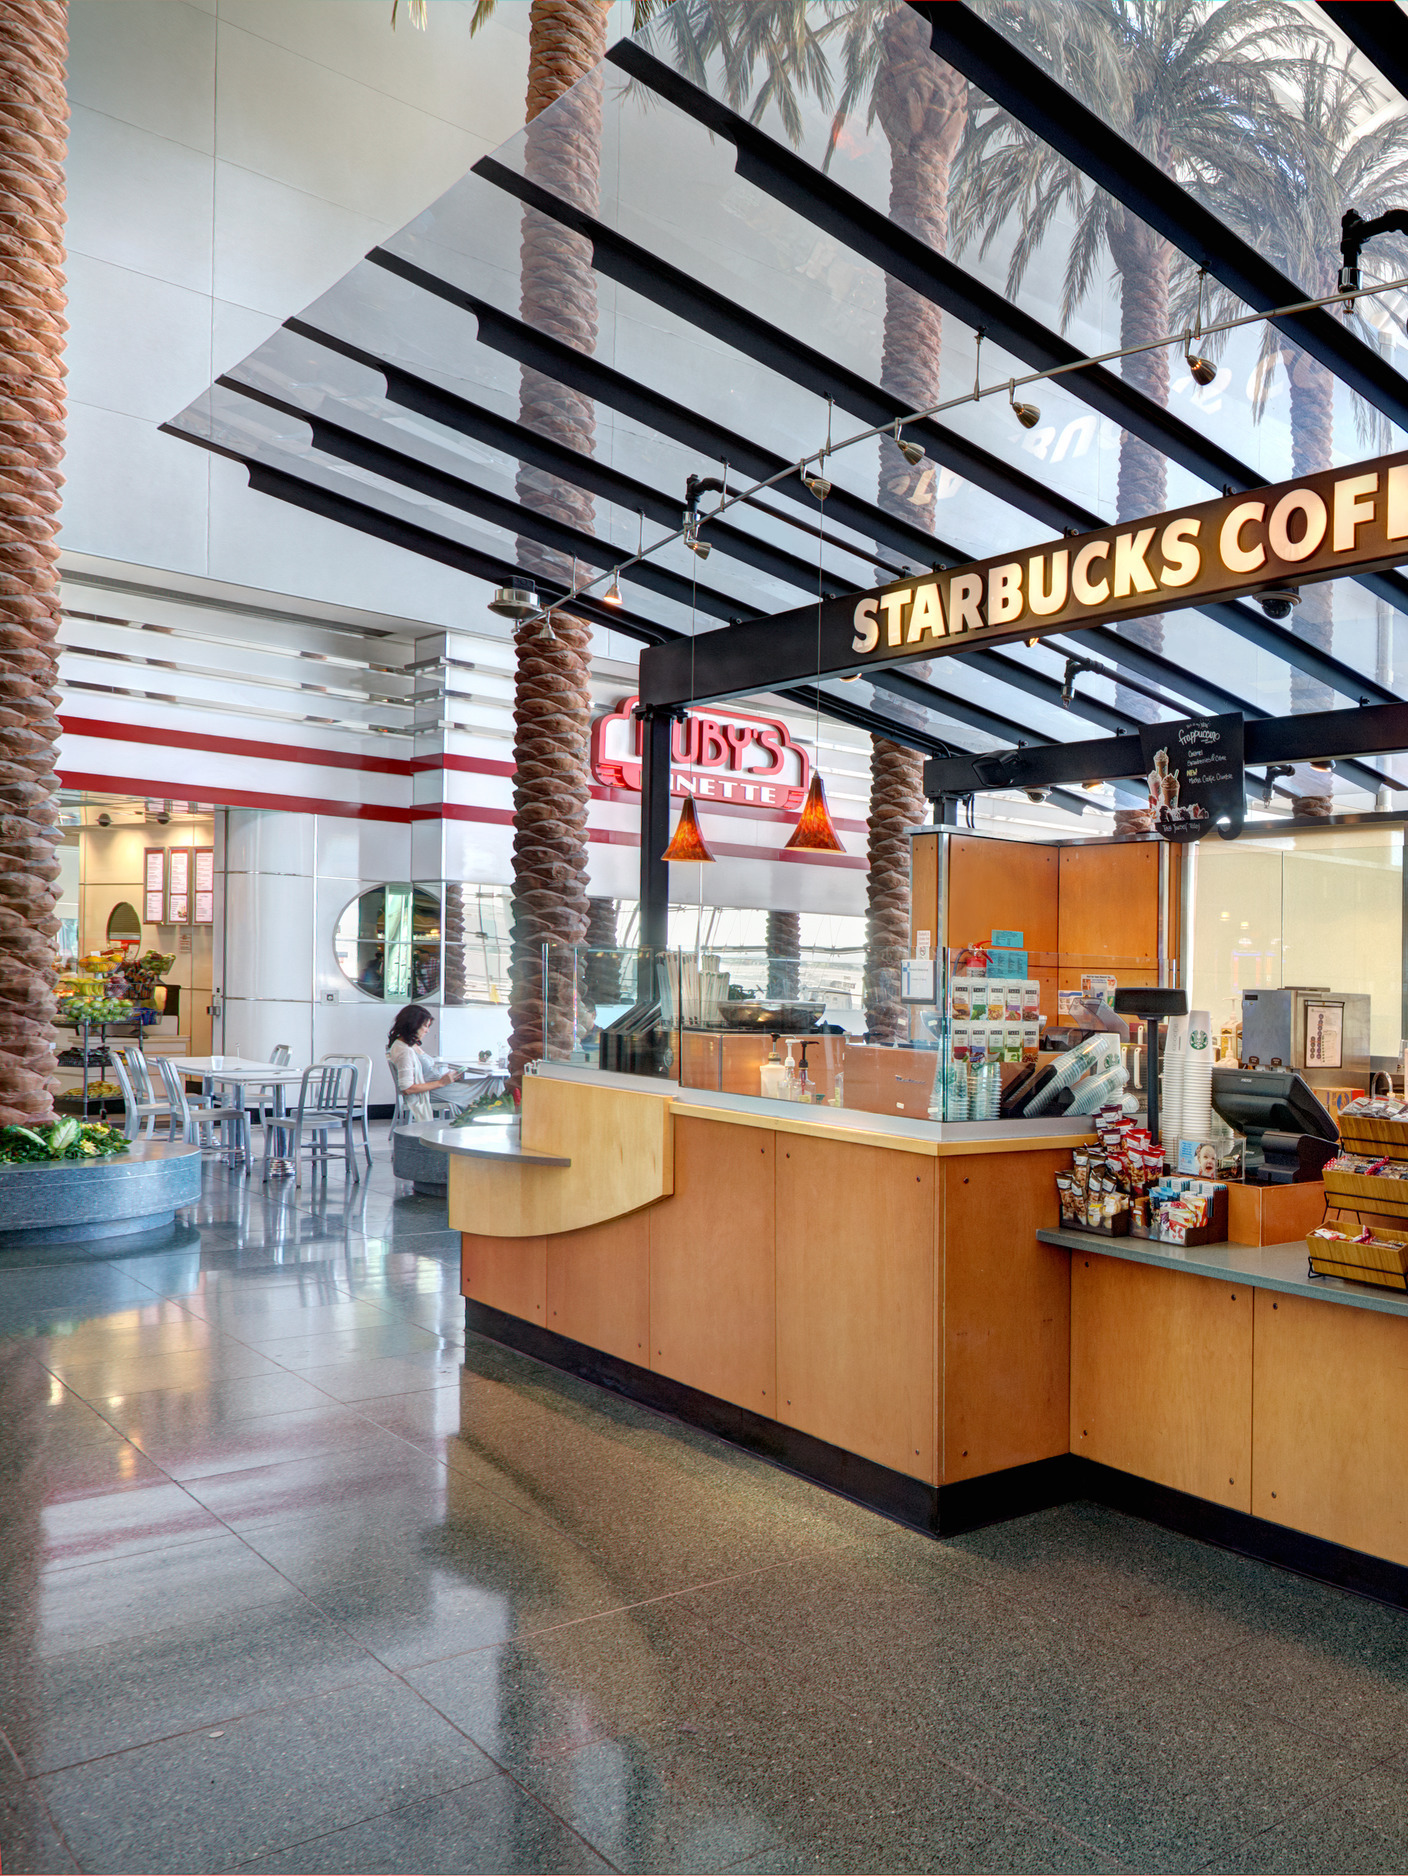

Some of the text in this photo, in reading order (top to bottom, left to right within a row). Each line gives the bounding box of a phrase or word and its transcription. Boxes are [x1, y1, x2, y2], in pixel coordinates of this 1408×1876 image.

[851, 518, 1200, 653] STARBUCKS
[634, 715, 785, 776] UBY'S
[670, 773, 776, 804] NETTE
